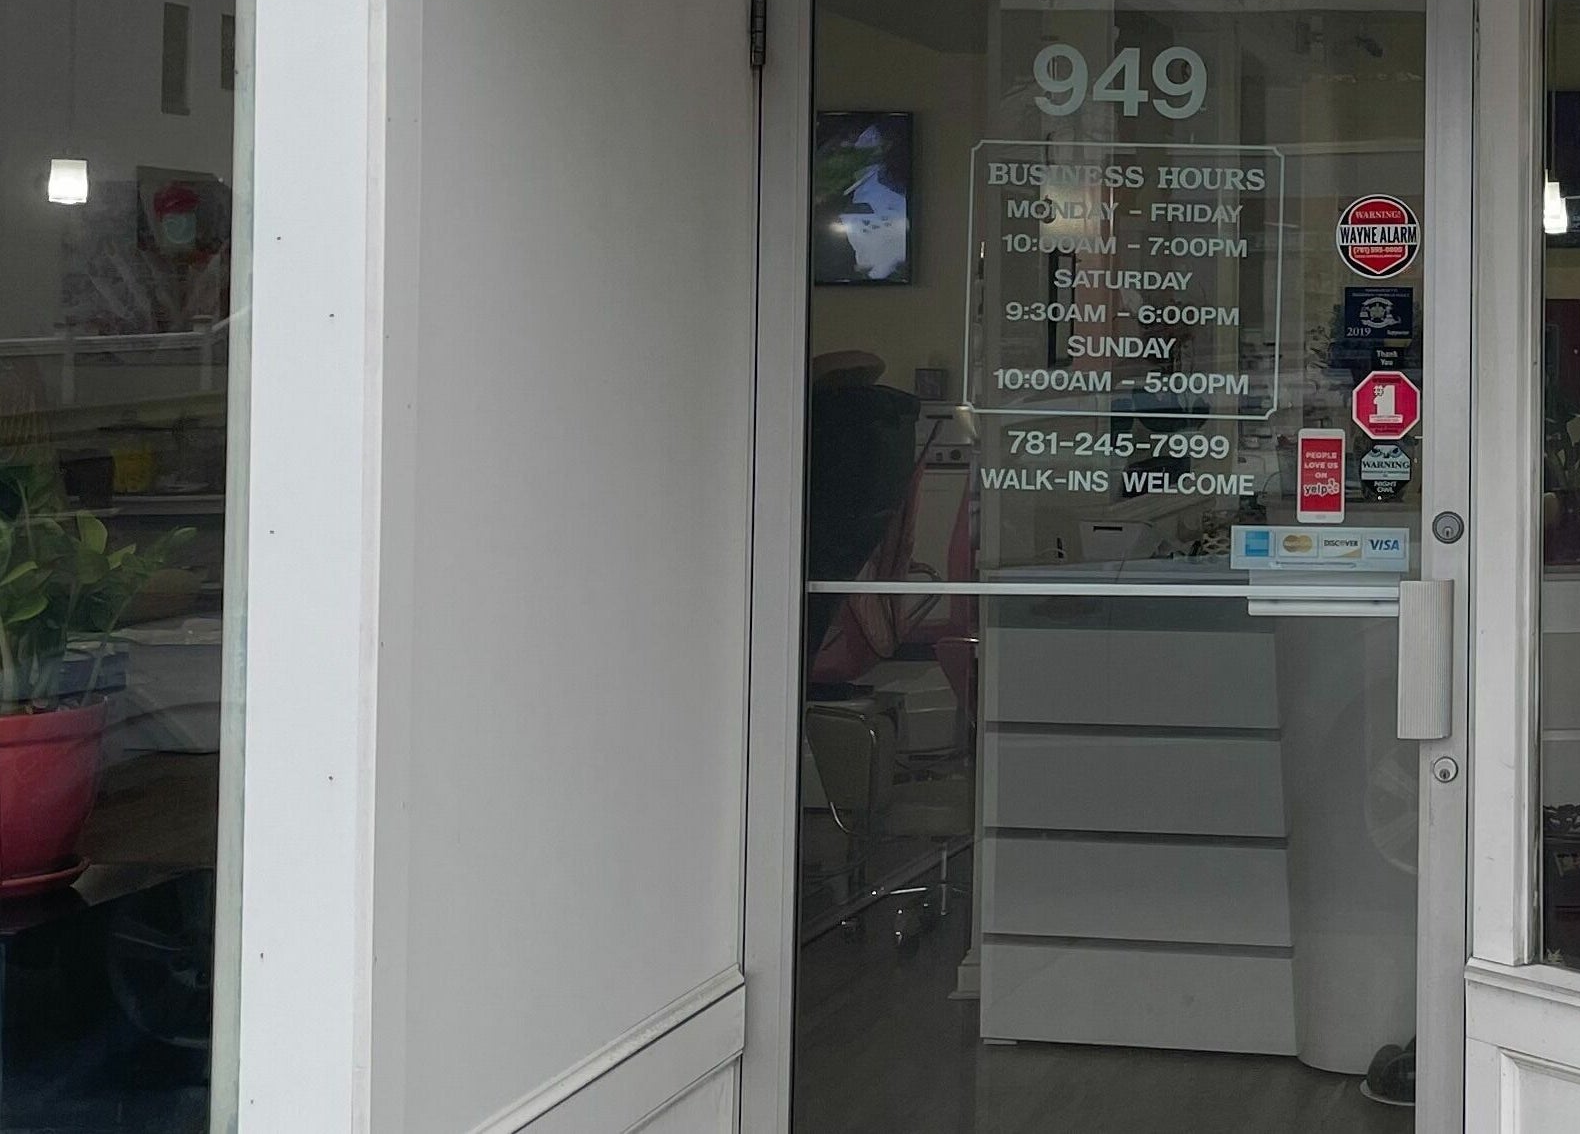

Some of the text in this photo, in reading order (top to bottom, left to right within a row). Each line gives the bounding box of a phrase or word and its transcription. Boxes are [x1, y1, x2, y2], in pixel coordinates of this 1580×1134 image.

[1033, 43, 1207, 119] 949
[988, 163, 1266, 191] BUSINESS HOURS
[1007, 199, 1119, 221] MONDAY
[1150, 203, 1243, 224] FRIDAY
[1002, 233, 1117, 255] 10:00AM
[1148, 237, 1248, 259] 7:00PM
[1340, 226, 1417, 244] WAYNE ALARM
[1053, 268, 1193, 291] SATURDAY
[1005, 301, 1106, 323] 9:30AM
[1137, 304, 1240, 326] 6:00PM
[1346, 327, 1372, 337] 2019
[1067, 335, 1177, 359] SUNDAY
[993, 368, 1112, 392] 10:00AM
[1143, 372, 1249, 395] 5:00PM
[1007, 430, 1230, 460] 781-245-7999
[1305, 451, 1338, 460] PEOPLE
[1304, 462, 1324, 470] LOVE
[1314, 471, 1328, 479] ON
[1362, 460, 1410, 469] WARNING
[980, 468, 1255, 496] WALK-INS WELCOME
[1304, 482, 1329, 497] yelp
[1323, 539, 1358, 548] DISCOVER
[1368, 538, 1400, 551] VISA
